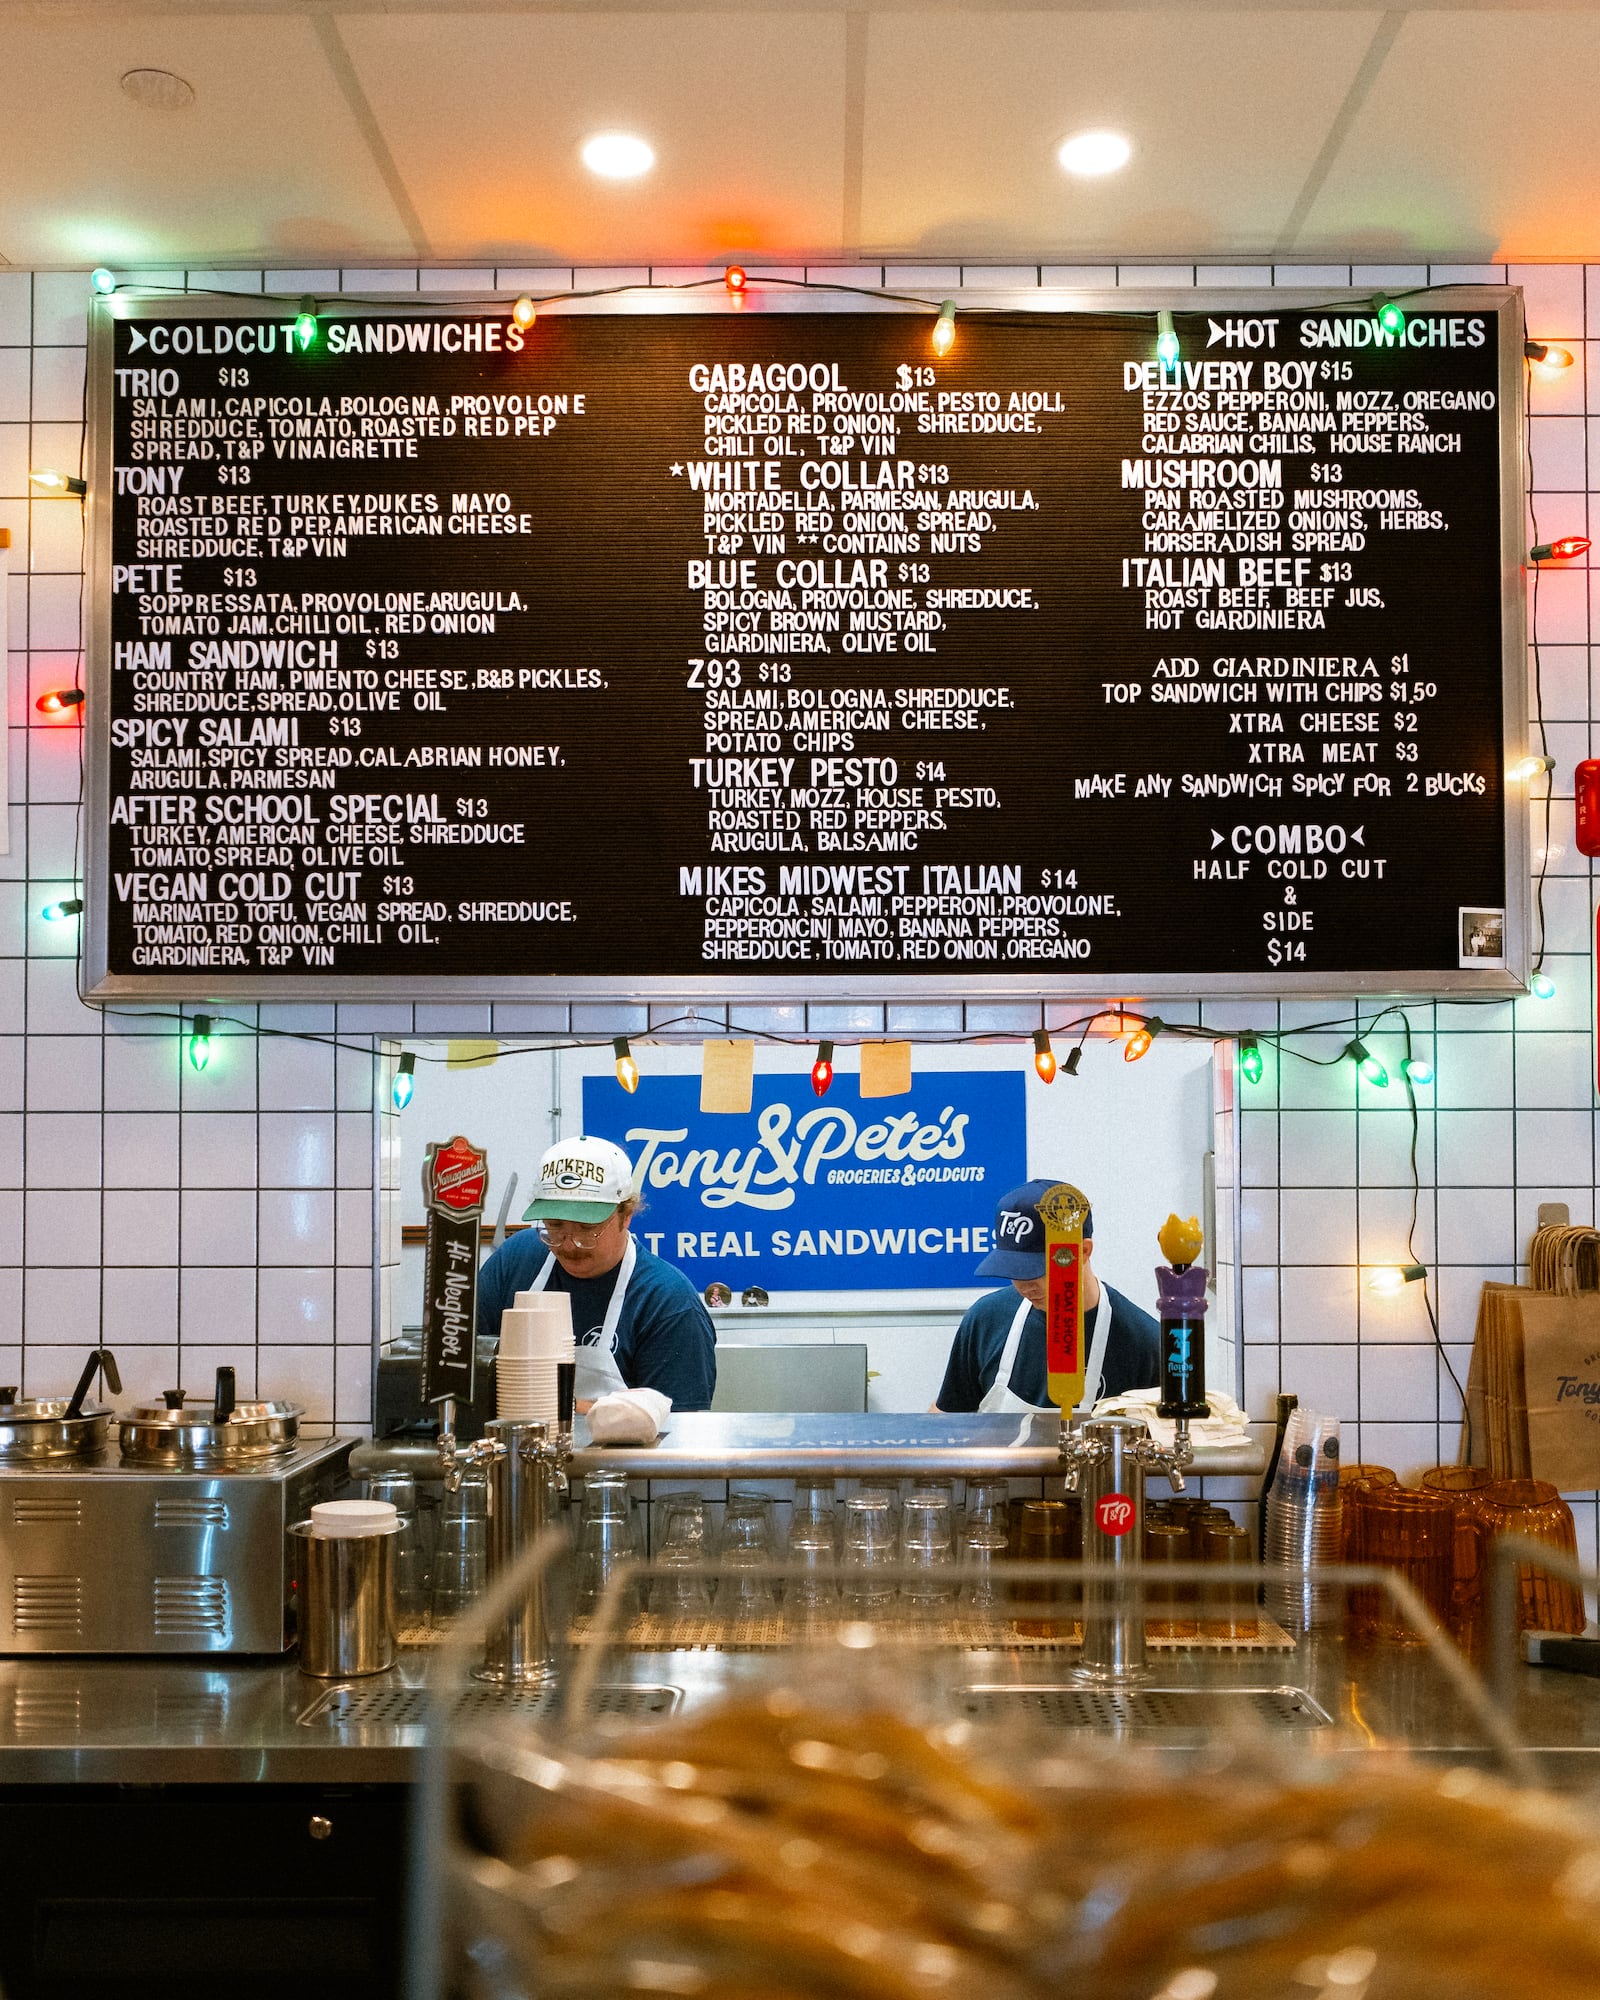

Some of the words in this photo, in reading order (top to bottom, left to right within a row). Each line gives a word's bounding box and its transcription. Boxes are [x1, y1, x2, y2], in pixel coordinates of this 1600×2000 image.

[327, 322, 525, 354] SANDWICHES
[1225, 319, 1279, 348] HOT
[114, 368, 179, 398] TRIO
[218, 367, 250, 388] $13
[688, 363, 848, 393] GABAGOOL
[896, 363, 937, 392] $13
[1123, 361, 1253, 391] DELIVERY
[1263, 360, 1317, 391] BOY
[1320, 360, 1353, 382] $15
[938, 392, 1001, 412] PESTO
[1142, 390, 1211, 412] EZZOS
[1403, 390, 1496, 411] OREGANO
[703, 414, 782, 435] PICKLED
[788, 414, 827, 434] RED
[1143, 412, 1181, 433] RED
[1258, 411, 1338, 433] BANANA
[272, 437, 418, 460] VINAIGRETTE
[703, 435, 755, 458] CHILI
[816, 434, 855, 456] T&P
[860, 434, 896, 456] VIN
[1141, 433, 1244, 455] CALABRIAN
[1330, 433, 1393, 454] HOUSE
[1397, 433, 1461, 454] RANCH
[114, 466, 184, 496] TONY
[218, 464, 251, 485] $13
[799, 461, 915, 491] COLLAR
[917, 463, 950, 484] $13
[1121, 458, 1282, 489] MUSHROOM
[1310, 462, 1343, 484] $13
[451, 492, 511, 515] MAYO
[1144, 489, 1181, 510] PAN
[1189, 489, 1285, 510] ROASTED
[136, 515, 229, 538] ROASTED
[237, 516, 282, 537] RED
[447, 513, 532, 536] CHEESE
[703, 511, 785, 534] PICKLED
[795, 511, 834, 533] RED
[1141, 510, 1281, 532] CARAMELIZED
[704, 534, 744, 556] T&P
[751, 532, 786, 556] VIN
[930, 531, 982, 555] NUTS
[1144, 531, 1282, 553] HORSERADISH
[1291, 531, 1366, 552] SPREAD
[113, 564, 183, 594] PETE
[223, 567, 258, 588] $13
[687, 560, 757, 590] BLUE
[776, 559, 888, 589] COLLAR
[898, 563, 931, 583] $13
[1122, 557, 1226, 588] ITALIAN
[1238, 557, 1312, 588] BEEF
[1319, 561, 1353, 583] $13
[1144, 588, 1211, 609] ROAST
[1286, 587, 1336, 608] BEEF
[138, 614, 220, 636] TOMATO
[702, 611, 762, 633] SPICY
[770, 610, 840, 632] BROWN
[1145, 609, 1185, 630] HOT
[1195, 609, 1326, 630] GIARDINIERA
[114, 640, 171, 671] HAM
[188, 638, 338, 671] SANDWICH
[365, 638, 400, 660] $13
[841, 632, 898, 653] OLIVE
[903, 632, 937, 654] OIL
[686, 659, 742, 689] Z93
[758, 663, 792, 683] $13
[1151, 659, 1200, 678] ADD
[1212, 658, 1380, 678] GIARDINIERA
[1390, 653, 1410, 676] $1
[132, 669, 227, 692] COUNTRY
[289, 668, 379, 691] PIMENTO
[1102, 684, 1142, 704] TOP
[1150, 683, 1257, 704] SANDWICH
[1265, 683, 1318, 703] WITH
[1325, 682, 1383, 703] CHIPS
[111, 717, 189, 749] SPICY
[198, 717, 299, 748] SALAMI
[329, 716, 362, 737] $13
[1229, 712, 1284, 734] XTRA
[1299, 712, 1380, 733] CHEESE
[1393, 711, 1418, 732] $2
[705, 731, 782, 754] POTATO
[793, 731, 855, 753] CHIPS
[1248, 743, 1305, 764] XTRA
[1322, 742, 1379, 763] MEAT
[1395, 741, 1419, 762] $3
[689, 758, 795, 788] TURKEY
[810, 757, 899, 787] PESTO
[916, 761, 946, 782] $14
[1074, 773, 1127, 799] MAKE
[1134, 773, 1173, 798] ANY
[1181, 773, 1283, 798] SANDWICH
[1291, 772, 1346, 797] SPICY
[1353, 772, 1392, 797] FOR
[1406, 772, 1419, 793] 2
[111, 794, 197, 826] AFTER
[205, 794, 321, 825] SCHOOL
[329, 793, 447, 825] SPECIAL
[456, 796, 489, 819] $13
[856, 788, 923, 808] HOUSE
[1579, 784, 1587, 826] FIRE
[708, 808, 801, 832] ROASTED
[810, 808, 848, 830] RED
[215, 824, 315, 846] AMERICAN
[409, 822, 525, 845] SHREDDUCE
[817, 830, 918, 852] BALSAMIC
[1231, 824, 1347, 855] COMBO
[301, 845, 364, 867] OLIVE
[368, 845, 405, 866] OIL
[679, 865, 767, 897] MIKES
[779, 864, 910, 896] MIDWEST
[922, 863, 1022, 896] ITALIAN
[1040, 868, 1078, 889] $14
[1193, 859, 1250, 880] HALF
[1267, 859, 1328, 880] COLD
[1341, 859, 1387, 879] CUT
[114, 871, 207, 903] VEGAN
[218, 871, 292, 903] COLD
[305, 870, 362, 903] CUT
[382, 875, 414, 896] $13
[1283, 887, 1297, 906] &
[133, 902, 239, 924] MARINATED
[305, 901, 367, 923] VEGAN
[1262, 911, 1314, 932] SIDE
[898, 916, 973, 939] BANANA
[256, 945, 293, 966] T&P
[301, 944, 335, 967] VIN
[1267, 937, 1307, 967] $14
[541, 1158, 605, 1184] PACKERS
[999, 1210, 1034, 1244] T&P
[677, 1232, 760, 1258] REAL
[1099, 1500, 1131, 1525] T&P
